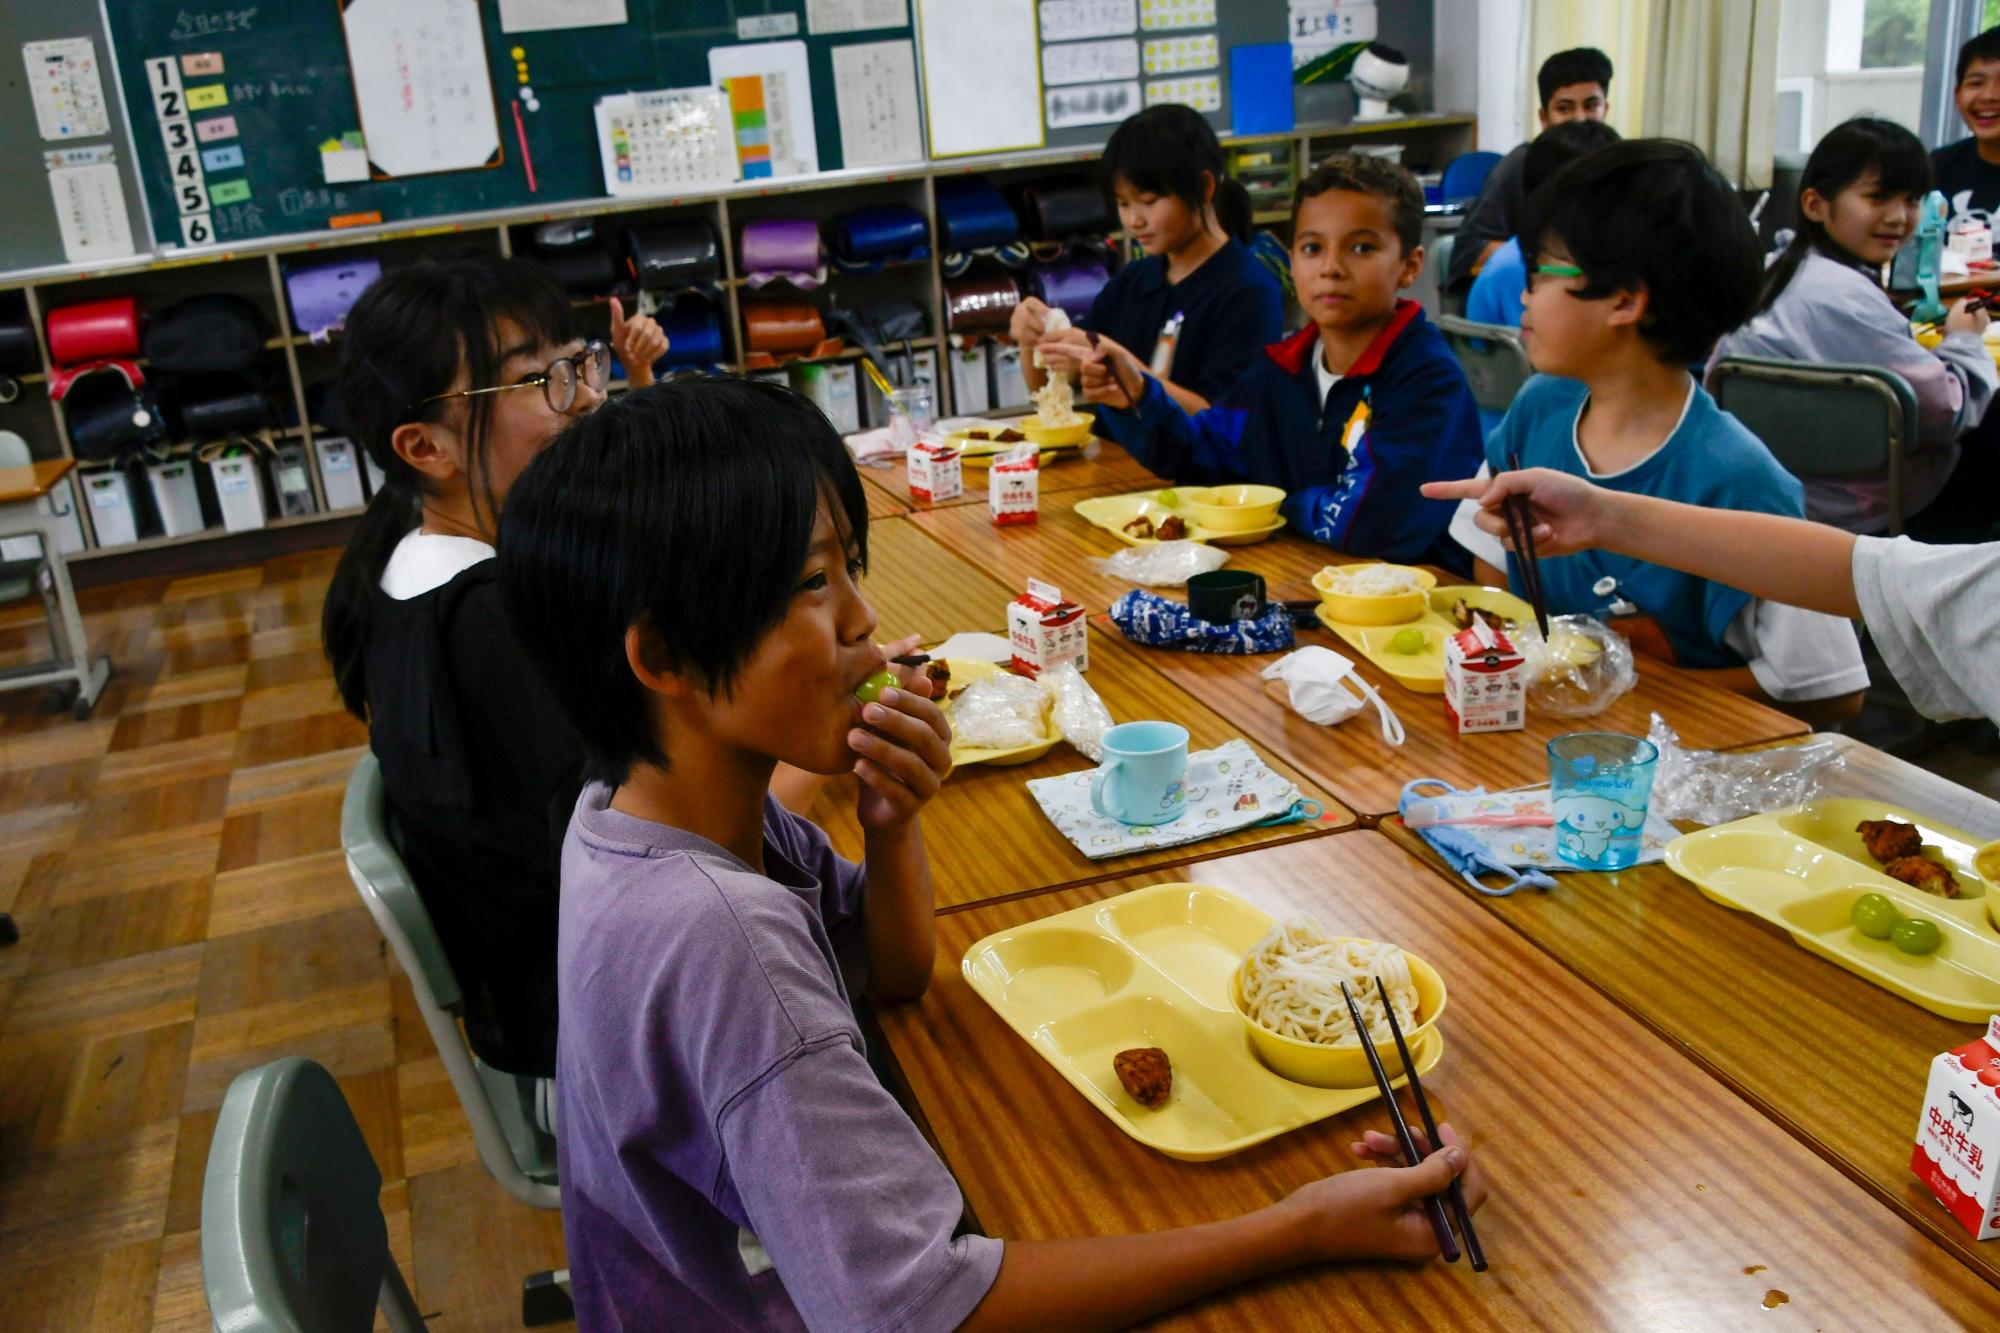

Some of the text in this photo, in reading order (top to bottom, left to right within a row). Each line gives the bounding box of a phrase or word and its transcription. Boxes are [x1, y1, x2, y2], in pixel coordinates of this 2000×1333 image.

[157, 61, 168, 86] 1
[161, 91, 180, 116] 2
[169, 123, 188, 148] 3
[178, 155, 196, 178] 4
[183, 186, 202, 210] 5
[190, 220, 207, 242] 6
[1929, 1106, 1984, 1171] 中央牛乳
